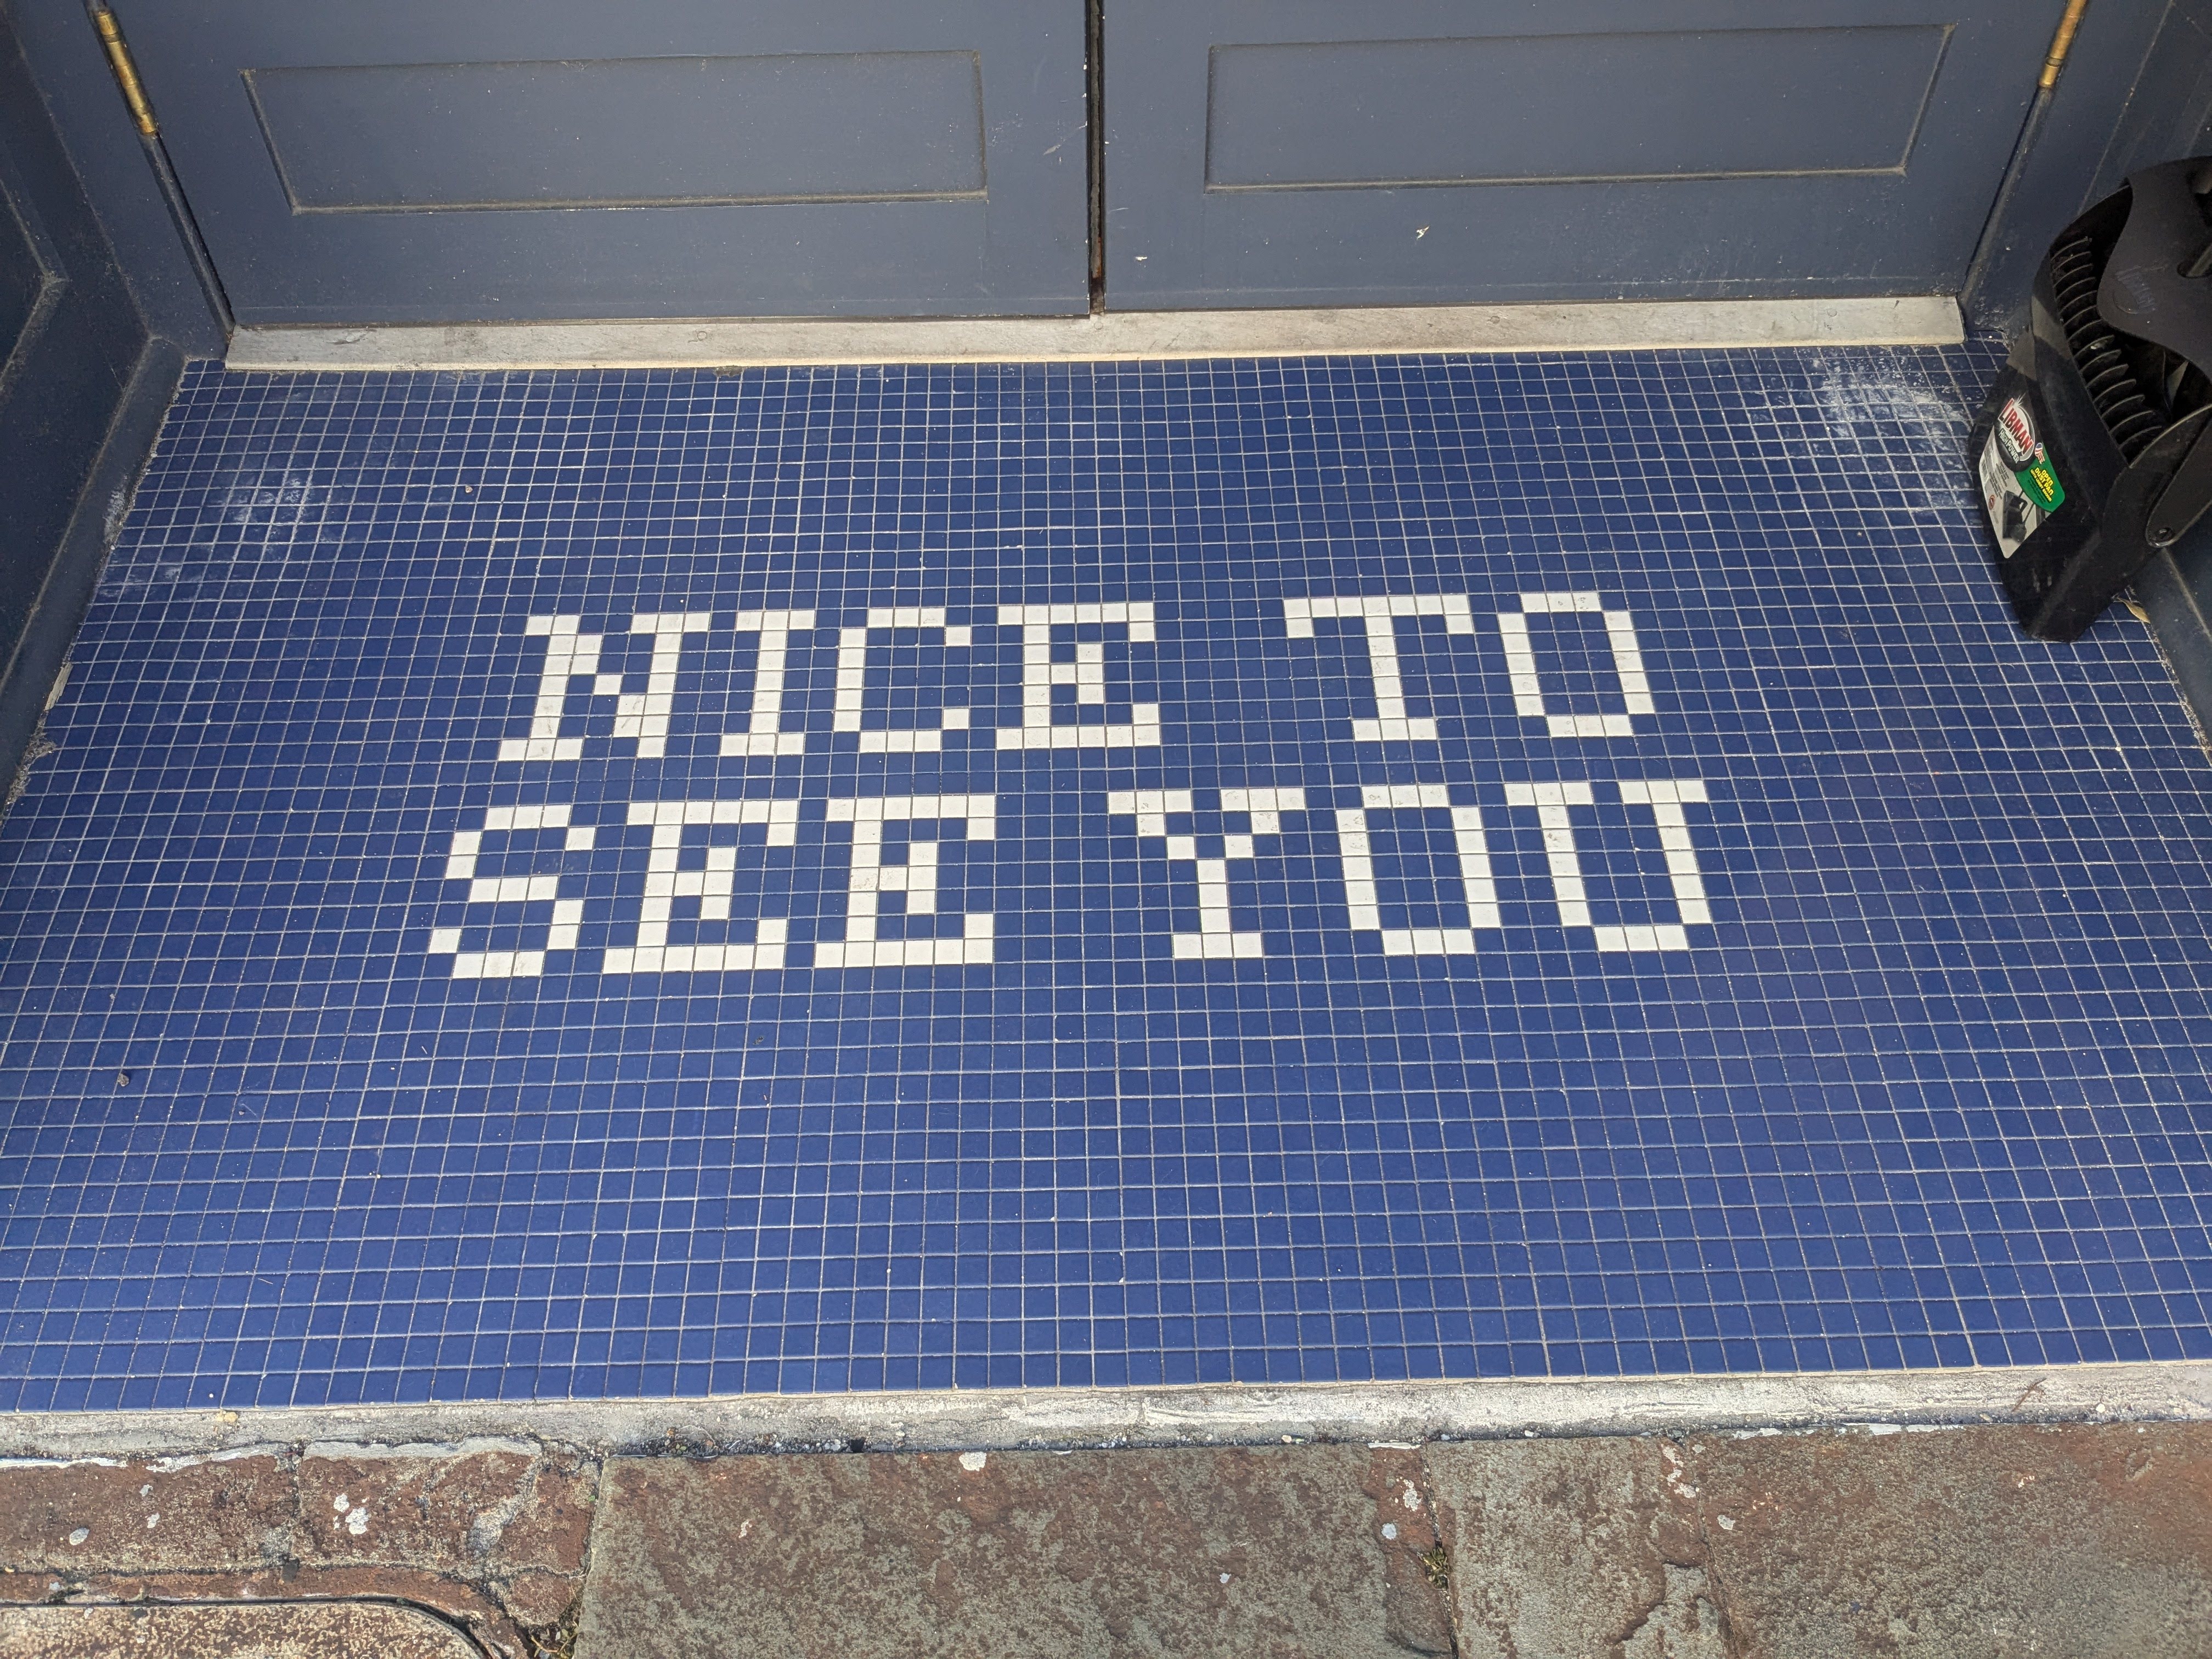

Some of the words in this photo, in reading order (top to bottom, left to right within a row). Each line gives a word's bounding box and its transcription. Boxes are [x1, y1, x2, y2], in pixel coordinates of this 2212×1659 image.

[1997, 398, 2034, 456] LIBMAN
[2006, 439, 2020, 464] POWER
[2035, 467, 2046, 483] DUST
[2044, 482, 2054, 496] PAN
[2042, 469, 2053, 486] OPEN
[498, 602, 1161, 761] NICE
[1284, 591, 1654, 742] TO
[428, 793, 996, 979] SEE
[1108, 779, 1712, 961] YOU
